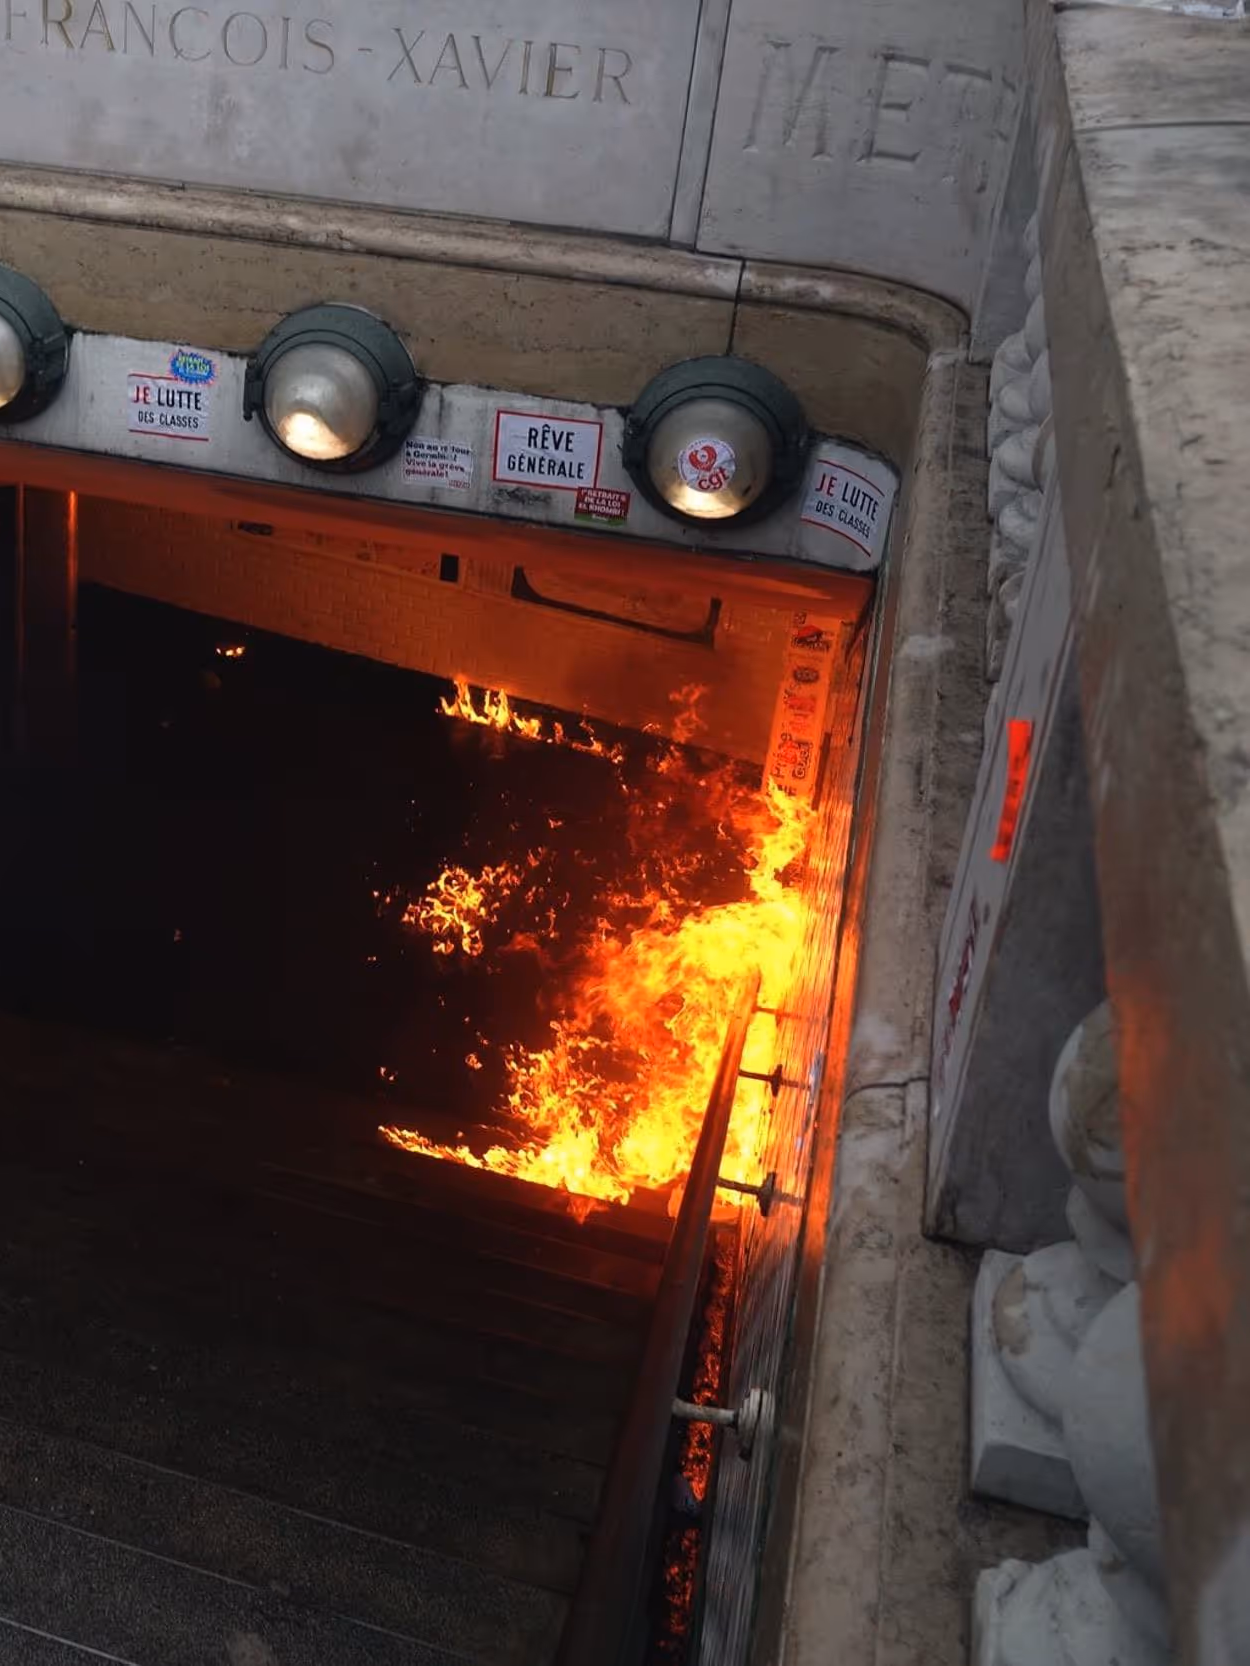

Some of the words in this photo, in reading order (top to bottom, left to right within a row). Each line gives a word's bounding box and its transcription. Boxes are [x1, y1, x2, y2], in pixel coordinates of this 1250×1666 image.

[133, 385, 150, 405] JE
[157, 387, 202, 411] LUTTE
[138, 410, 154, 424] DES
[159, 412, 199, 429] CLASSES
[528, 424, 575, 453] RÊVE
[507, 453, 585, 479] GÉNÉRALE
[698, 466, 730, 490] cgt
[815, 472, 838, 498] JE
[842, 481, 879, 521] LUTTE
[816, 500, 835, 517] DES
[838, 509, 870, 539] CLASSES
